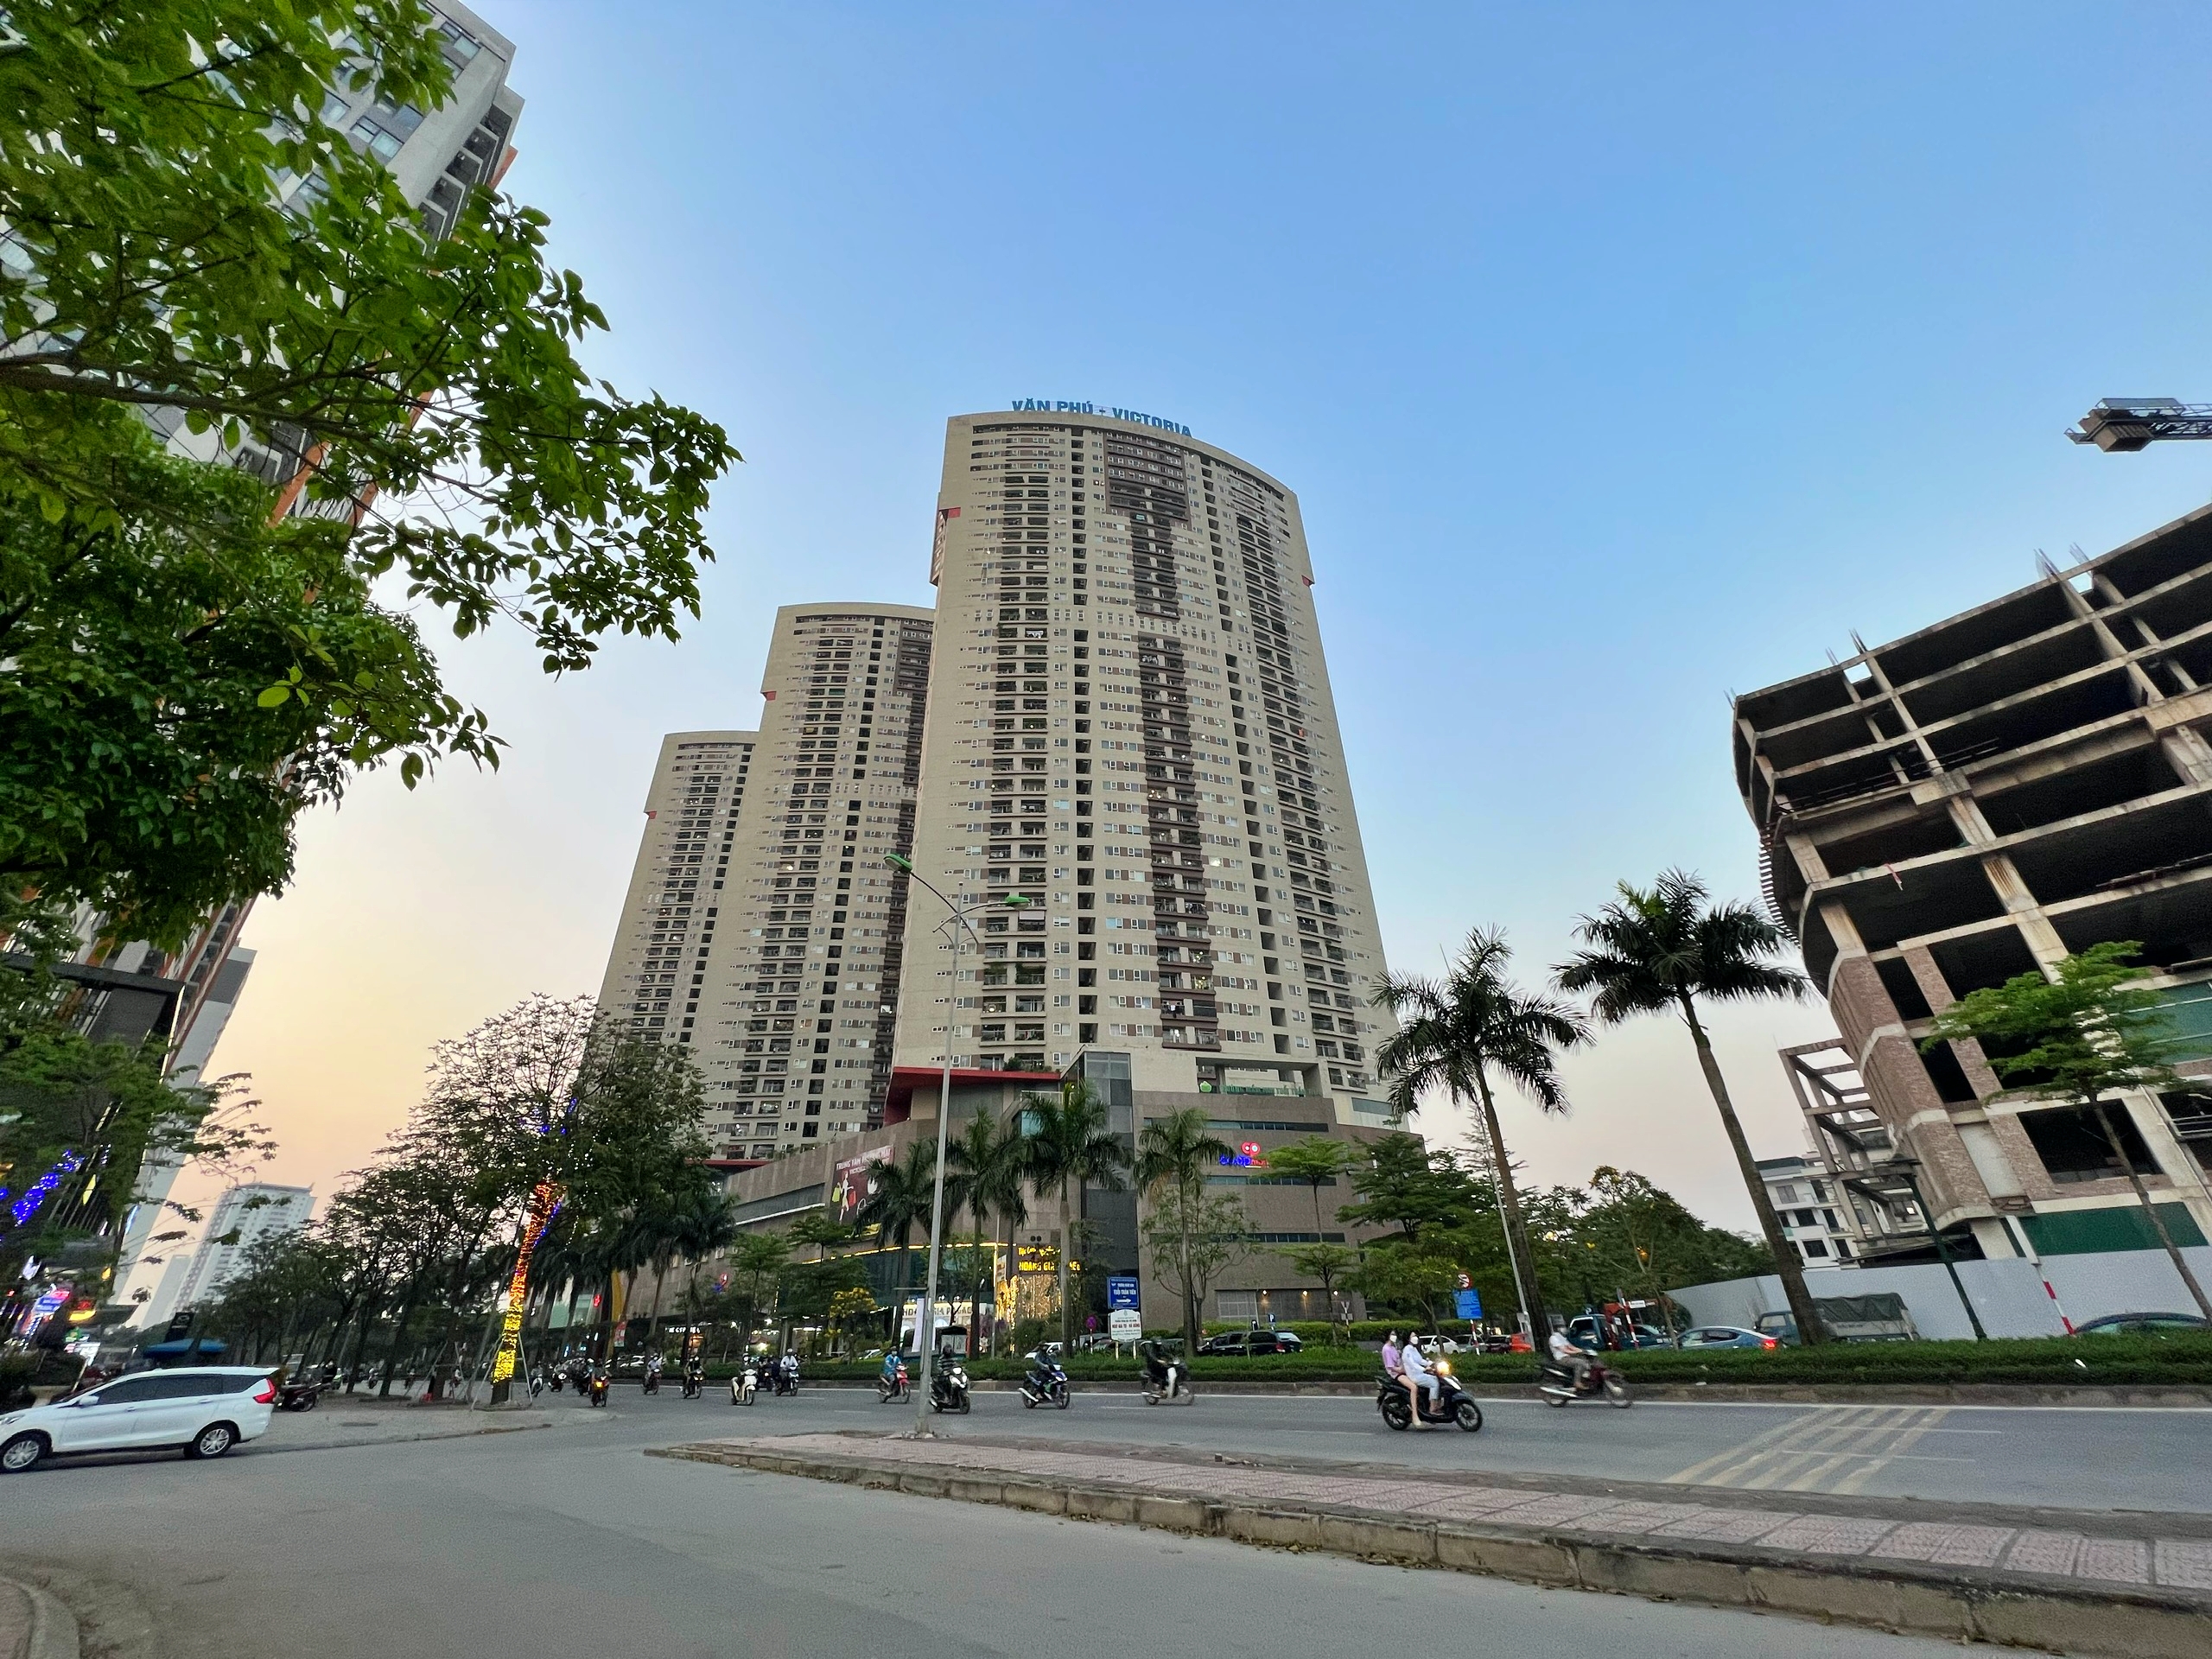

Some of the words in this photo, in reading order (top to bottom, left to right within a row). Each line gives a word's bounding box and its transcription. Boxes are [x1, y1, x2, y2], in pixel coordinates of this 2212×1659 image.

[1012, 397, 1051, 411] VĂN
[1057, 400, 1093, 415] PHÚ
[1112, 407, 1192, 437] VICTORIA
